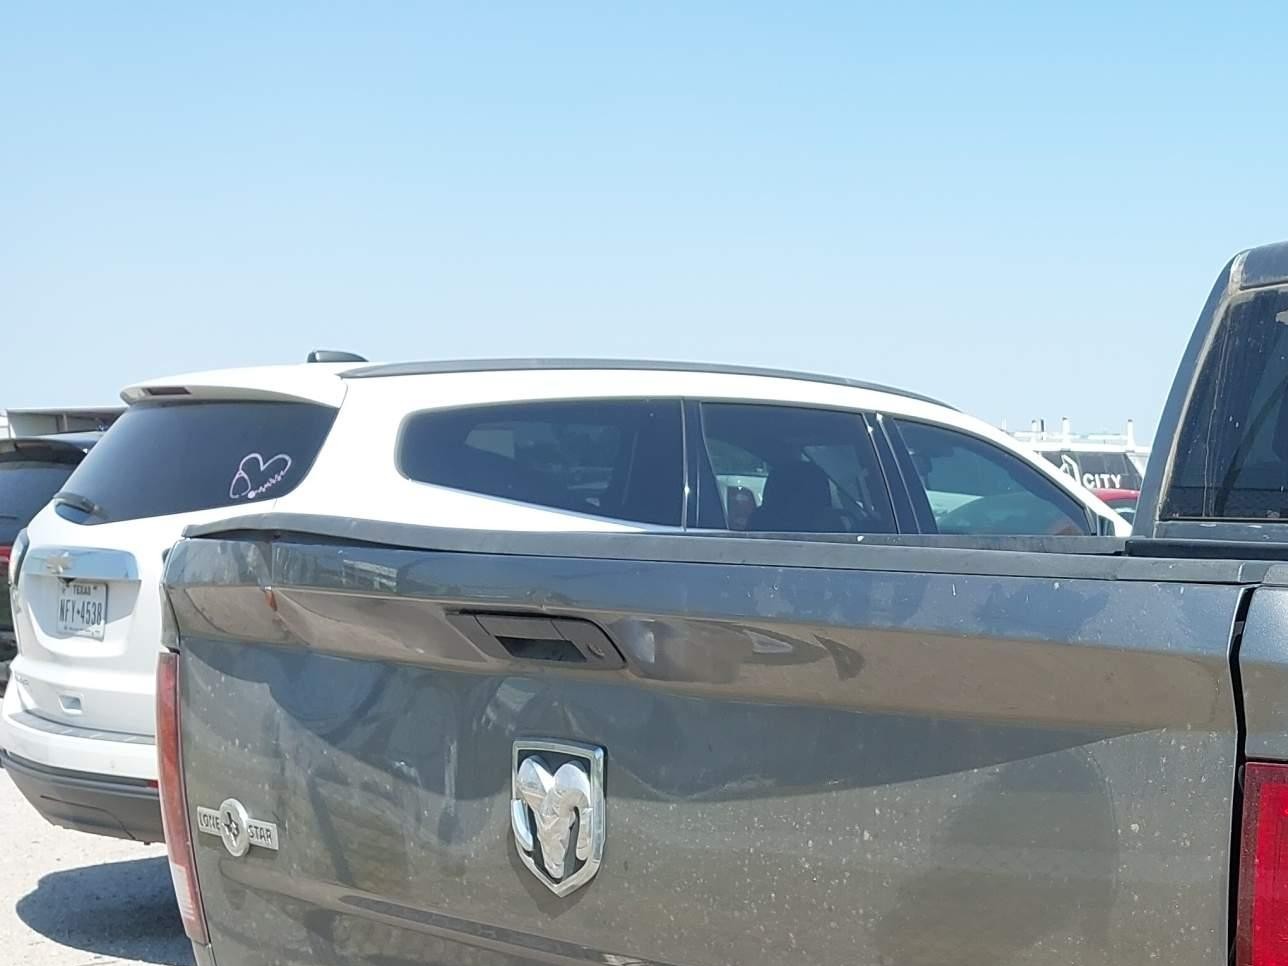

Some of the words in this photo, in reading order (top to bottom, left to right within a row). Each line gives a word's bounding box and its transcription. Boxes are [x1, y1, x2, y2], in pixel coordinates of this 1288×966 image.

[1083, 473, 1121, 489] CITY
[73, 585, 91, 595] TEXAS
[199, 811, 220, 831] LONE
[248, 825, 272, 845] STAR
